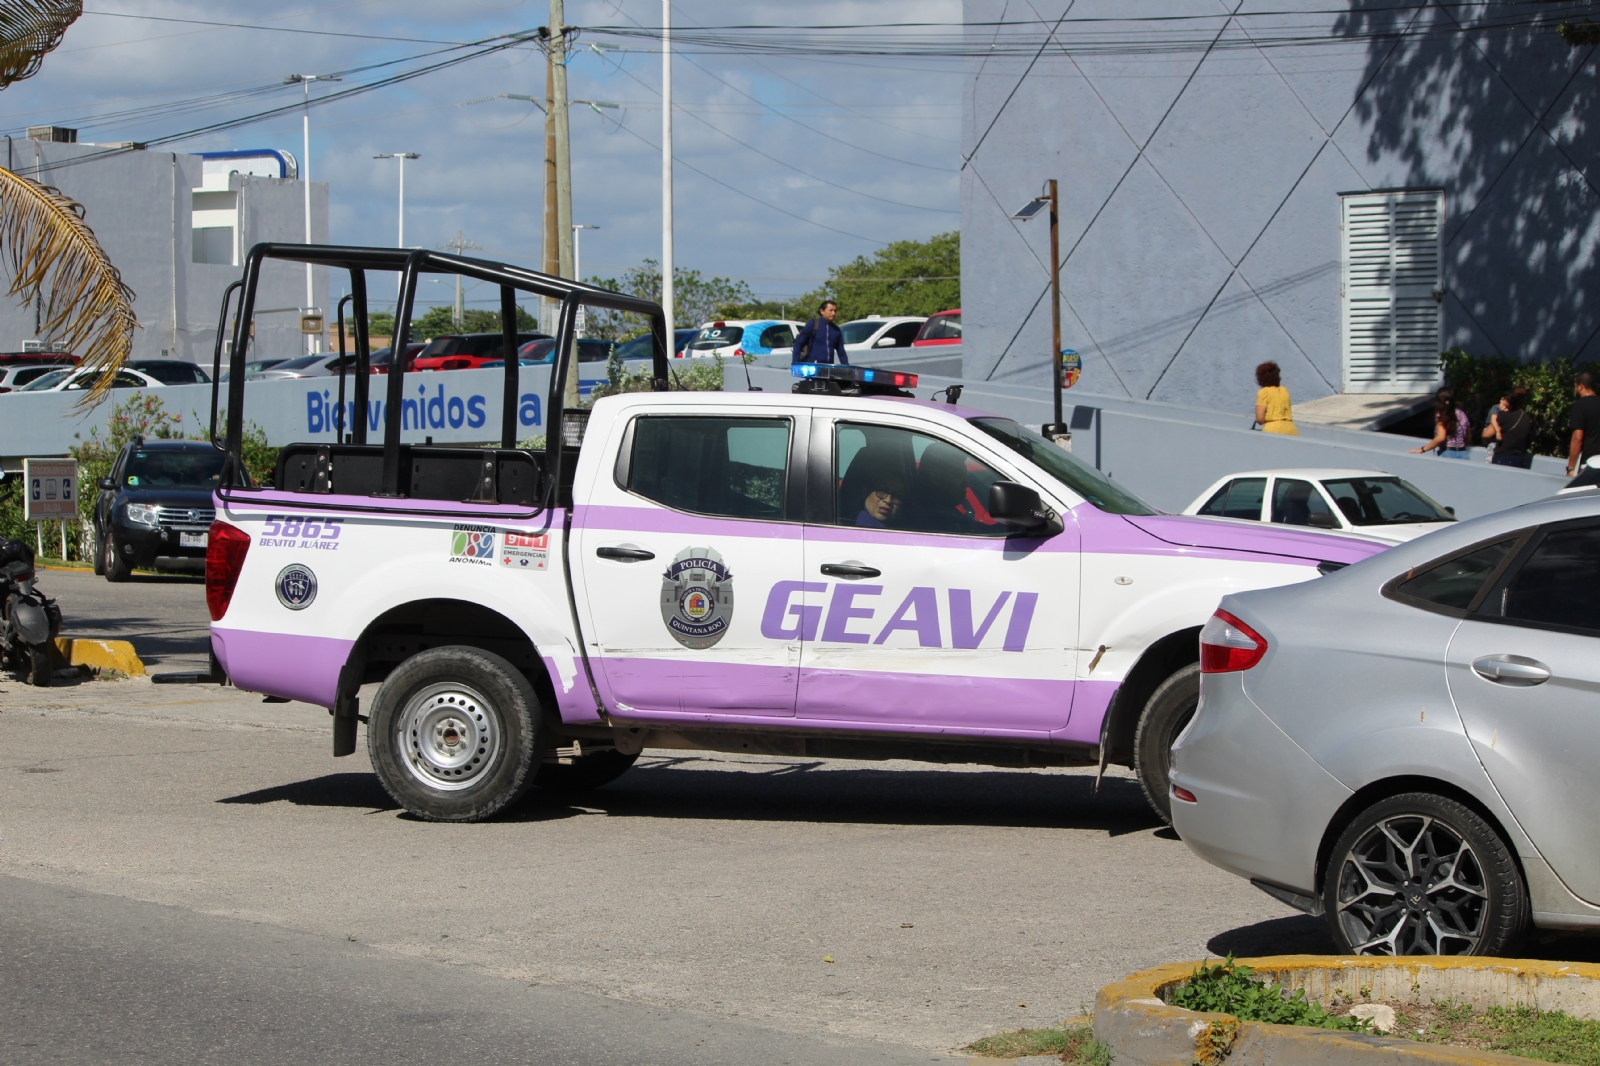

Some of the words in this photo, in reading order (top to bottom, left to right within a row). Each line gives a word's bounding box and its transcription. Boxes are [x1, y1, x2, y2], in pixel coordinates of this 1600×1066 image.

[307, 383, 486, 434] Bievnidos
[519, 393, 542, 427] a
[261, 514, 345, 540] 5865
[453, 524, 496, 534] DENUNCIA
[259, 538, 296, 548] BENITO
[298, 538, 340, 551] JUÁREZ
[450, 531, 495, 558] 089
[507, 533, 545, 546] 911
[503, 550, 546, 558] EMERGENCIAS
[760, 580, 1039, 652] GEAVI
[672, 620, 708, 634] QUINTANA
[708, 620, 722, 632] ROO
